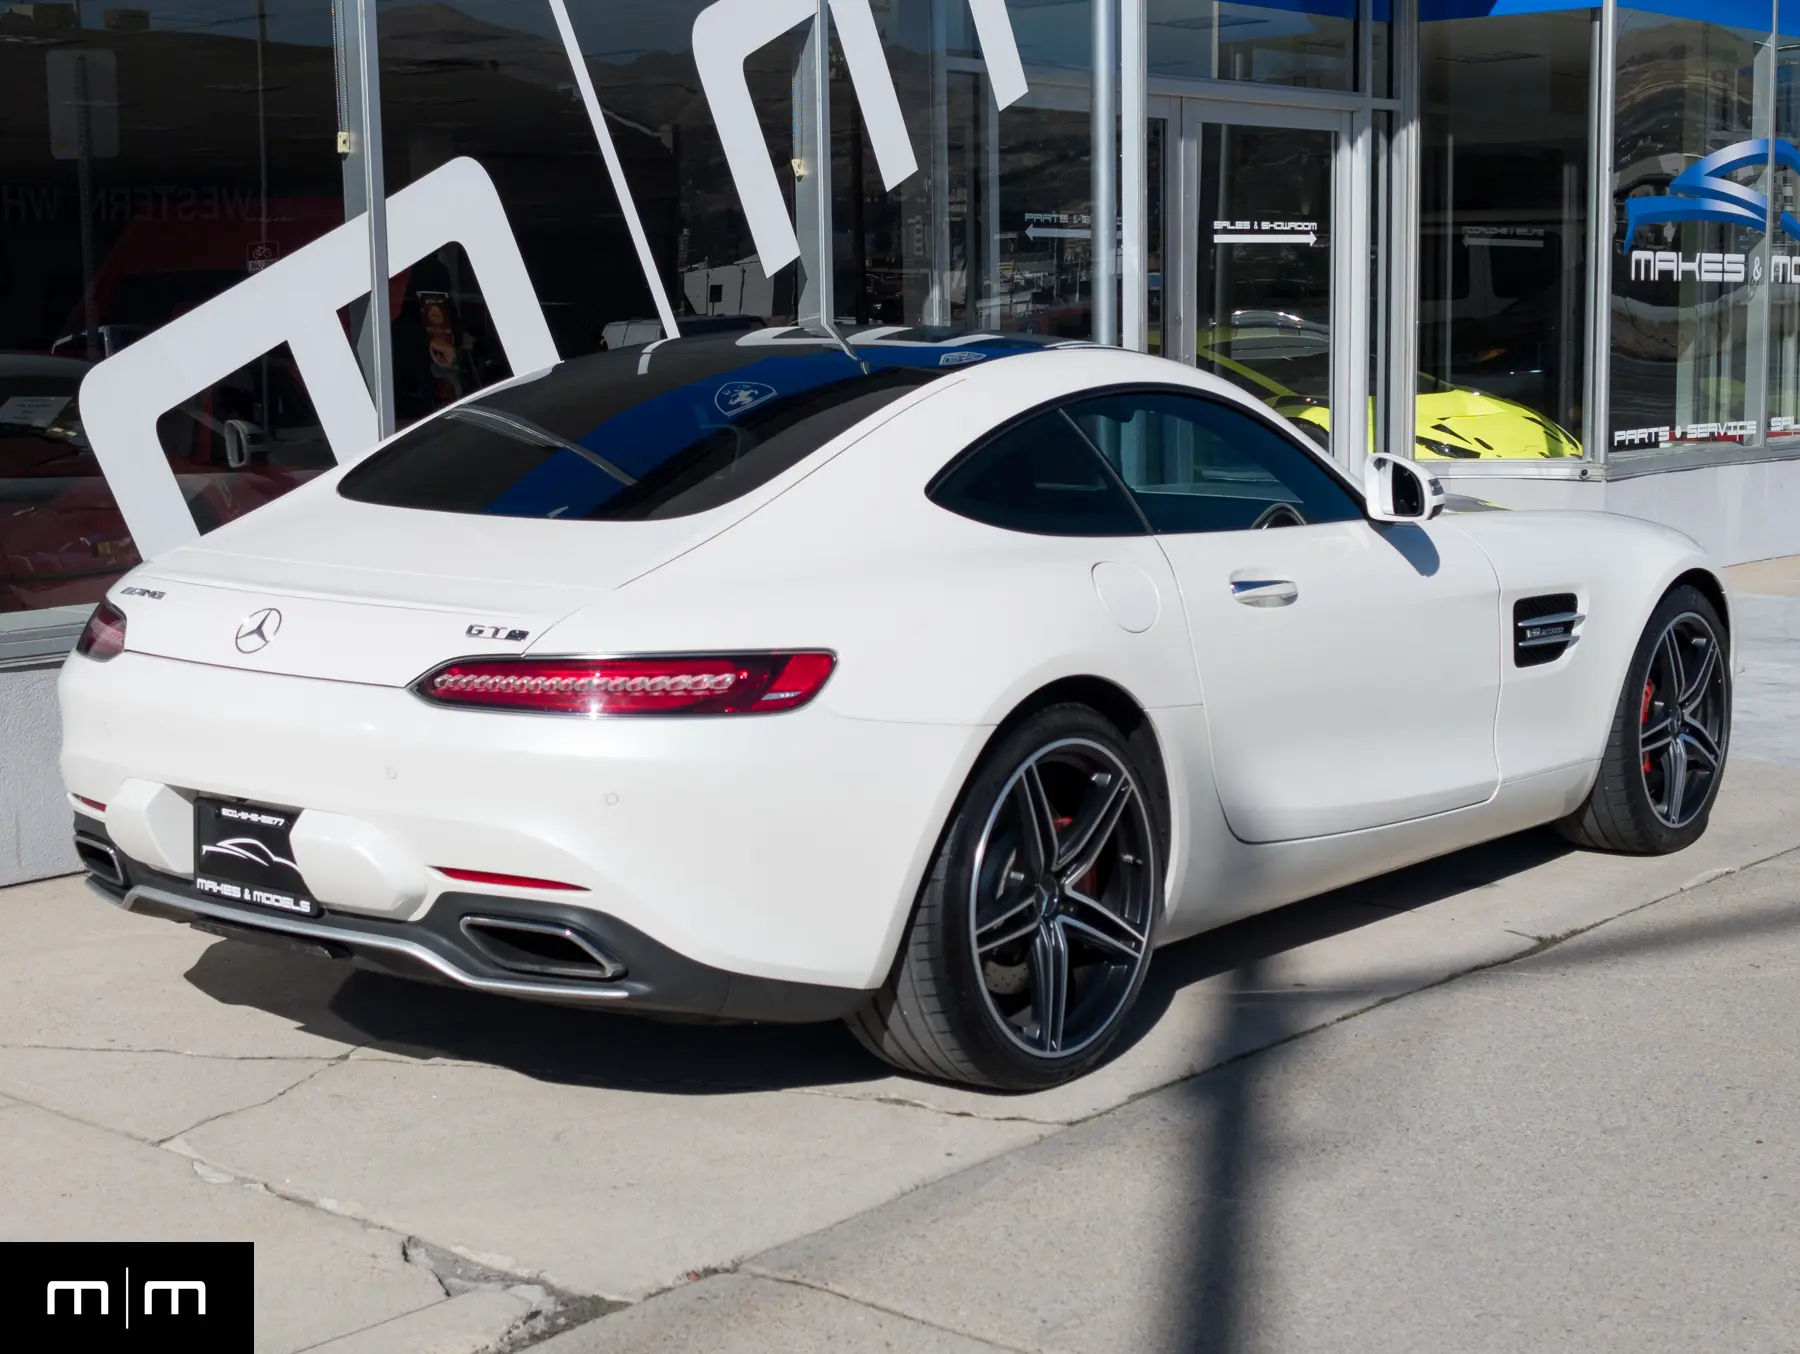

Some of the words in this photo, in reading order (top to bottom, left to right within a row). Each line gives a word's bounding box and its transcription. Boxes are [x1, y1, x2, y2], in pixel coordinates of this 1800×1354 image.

[1024, 213, 1069, 225] PARTS
[1213, 220, 1251, 230] SALES
[1253, 220, 1259, 230] &
[1261, 221, 1318, 231] SHOWROOM
[1631, 250, 1746, 283] MAKES
[1753, 256, 1762, 281] &
[1614, 426, 1670, 447] PARTS
[1686, 420, 1757, 441] SERVICE
[196, 878, 242, 899] MAKES
[243, 888, 252, 901] &
[252, 890, 311, 913] MODELS
